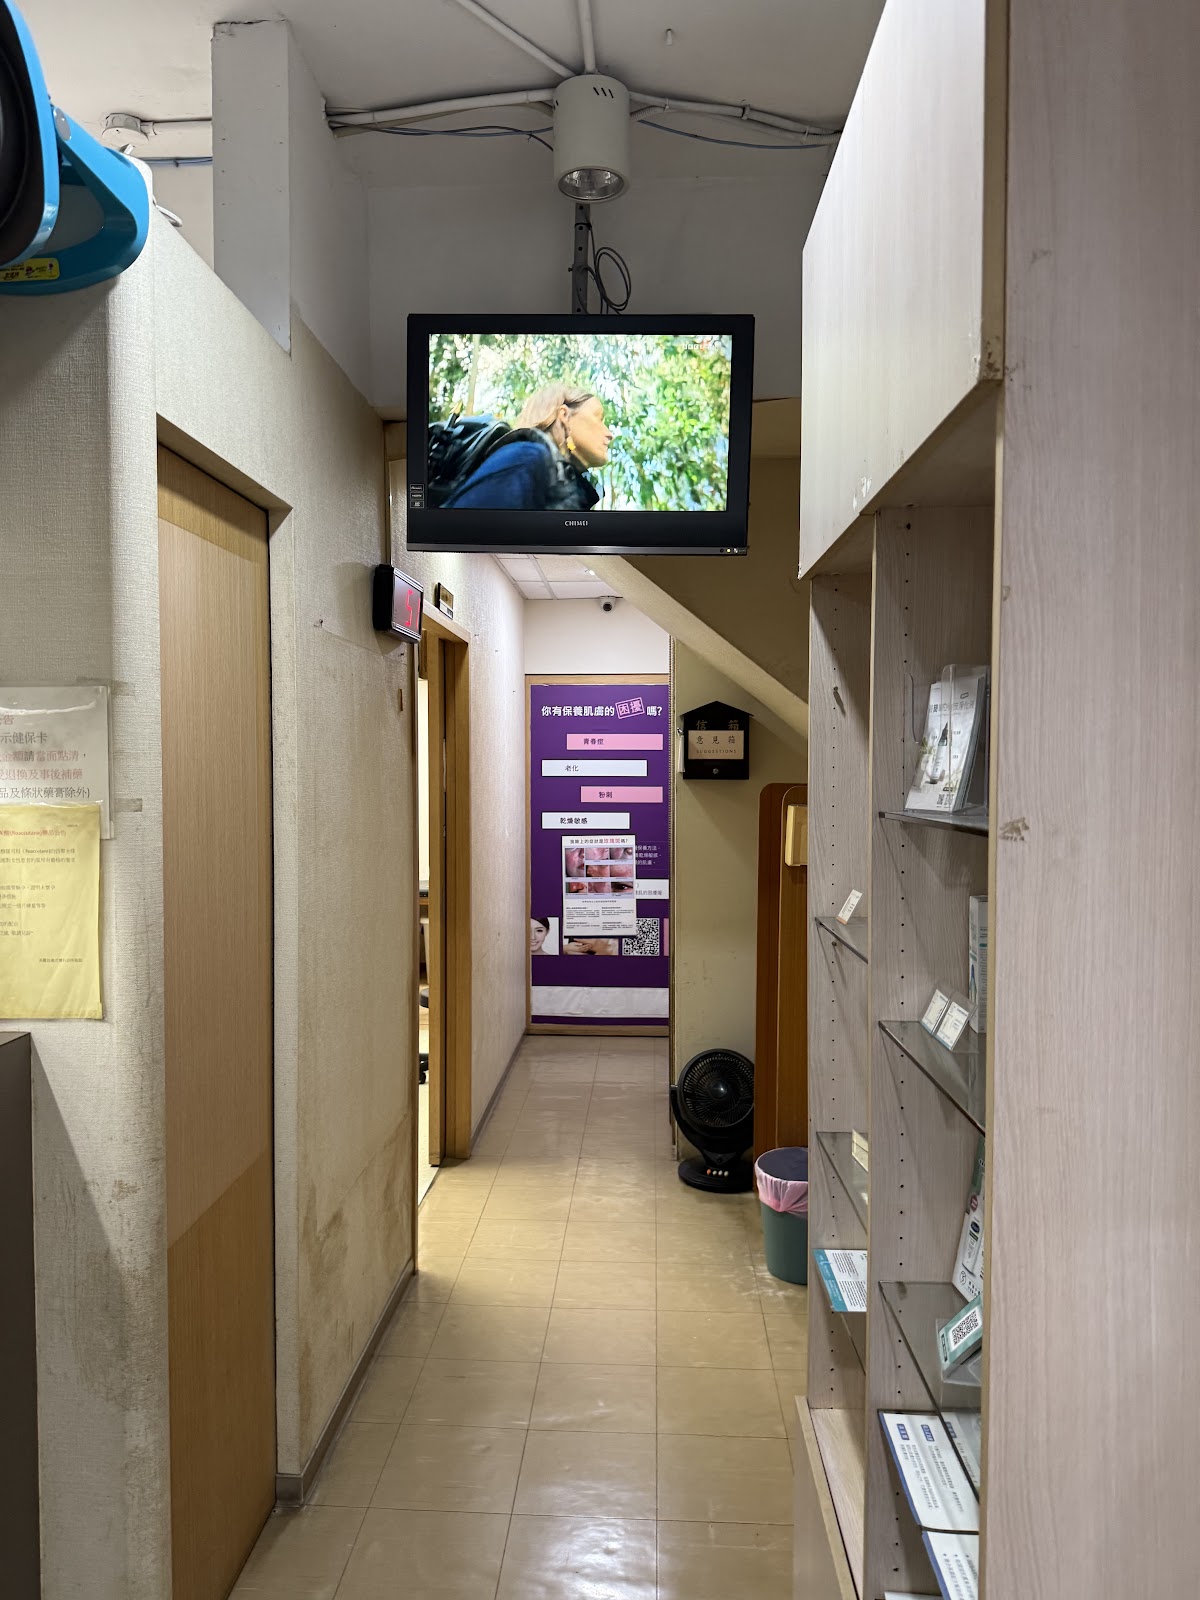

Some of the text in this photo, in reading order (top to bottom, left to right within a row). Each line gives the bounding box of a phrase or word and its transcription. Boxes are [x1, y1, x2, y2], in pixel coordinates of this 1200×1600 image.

[541, 700, 663, 717] 你有保養肌膚的 困擾 嗎?
[0, 714, 14, 726] 告
[696, 735, 736, 745] 意見箱
[565, 764, 579, 772] 老化
[560, 817, 588, 825] 乾燥敏感
